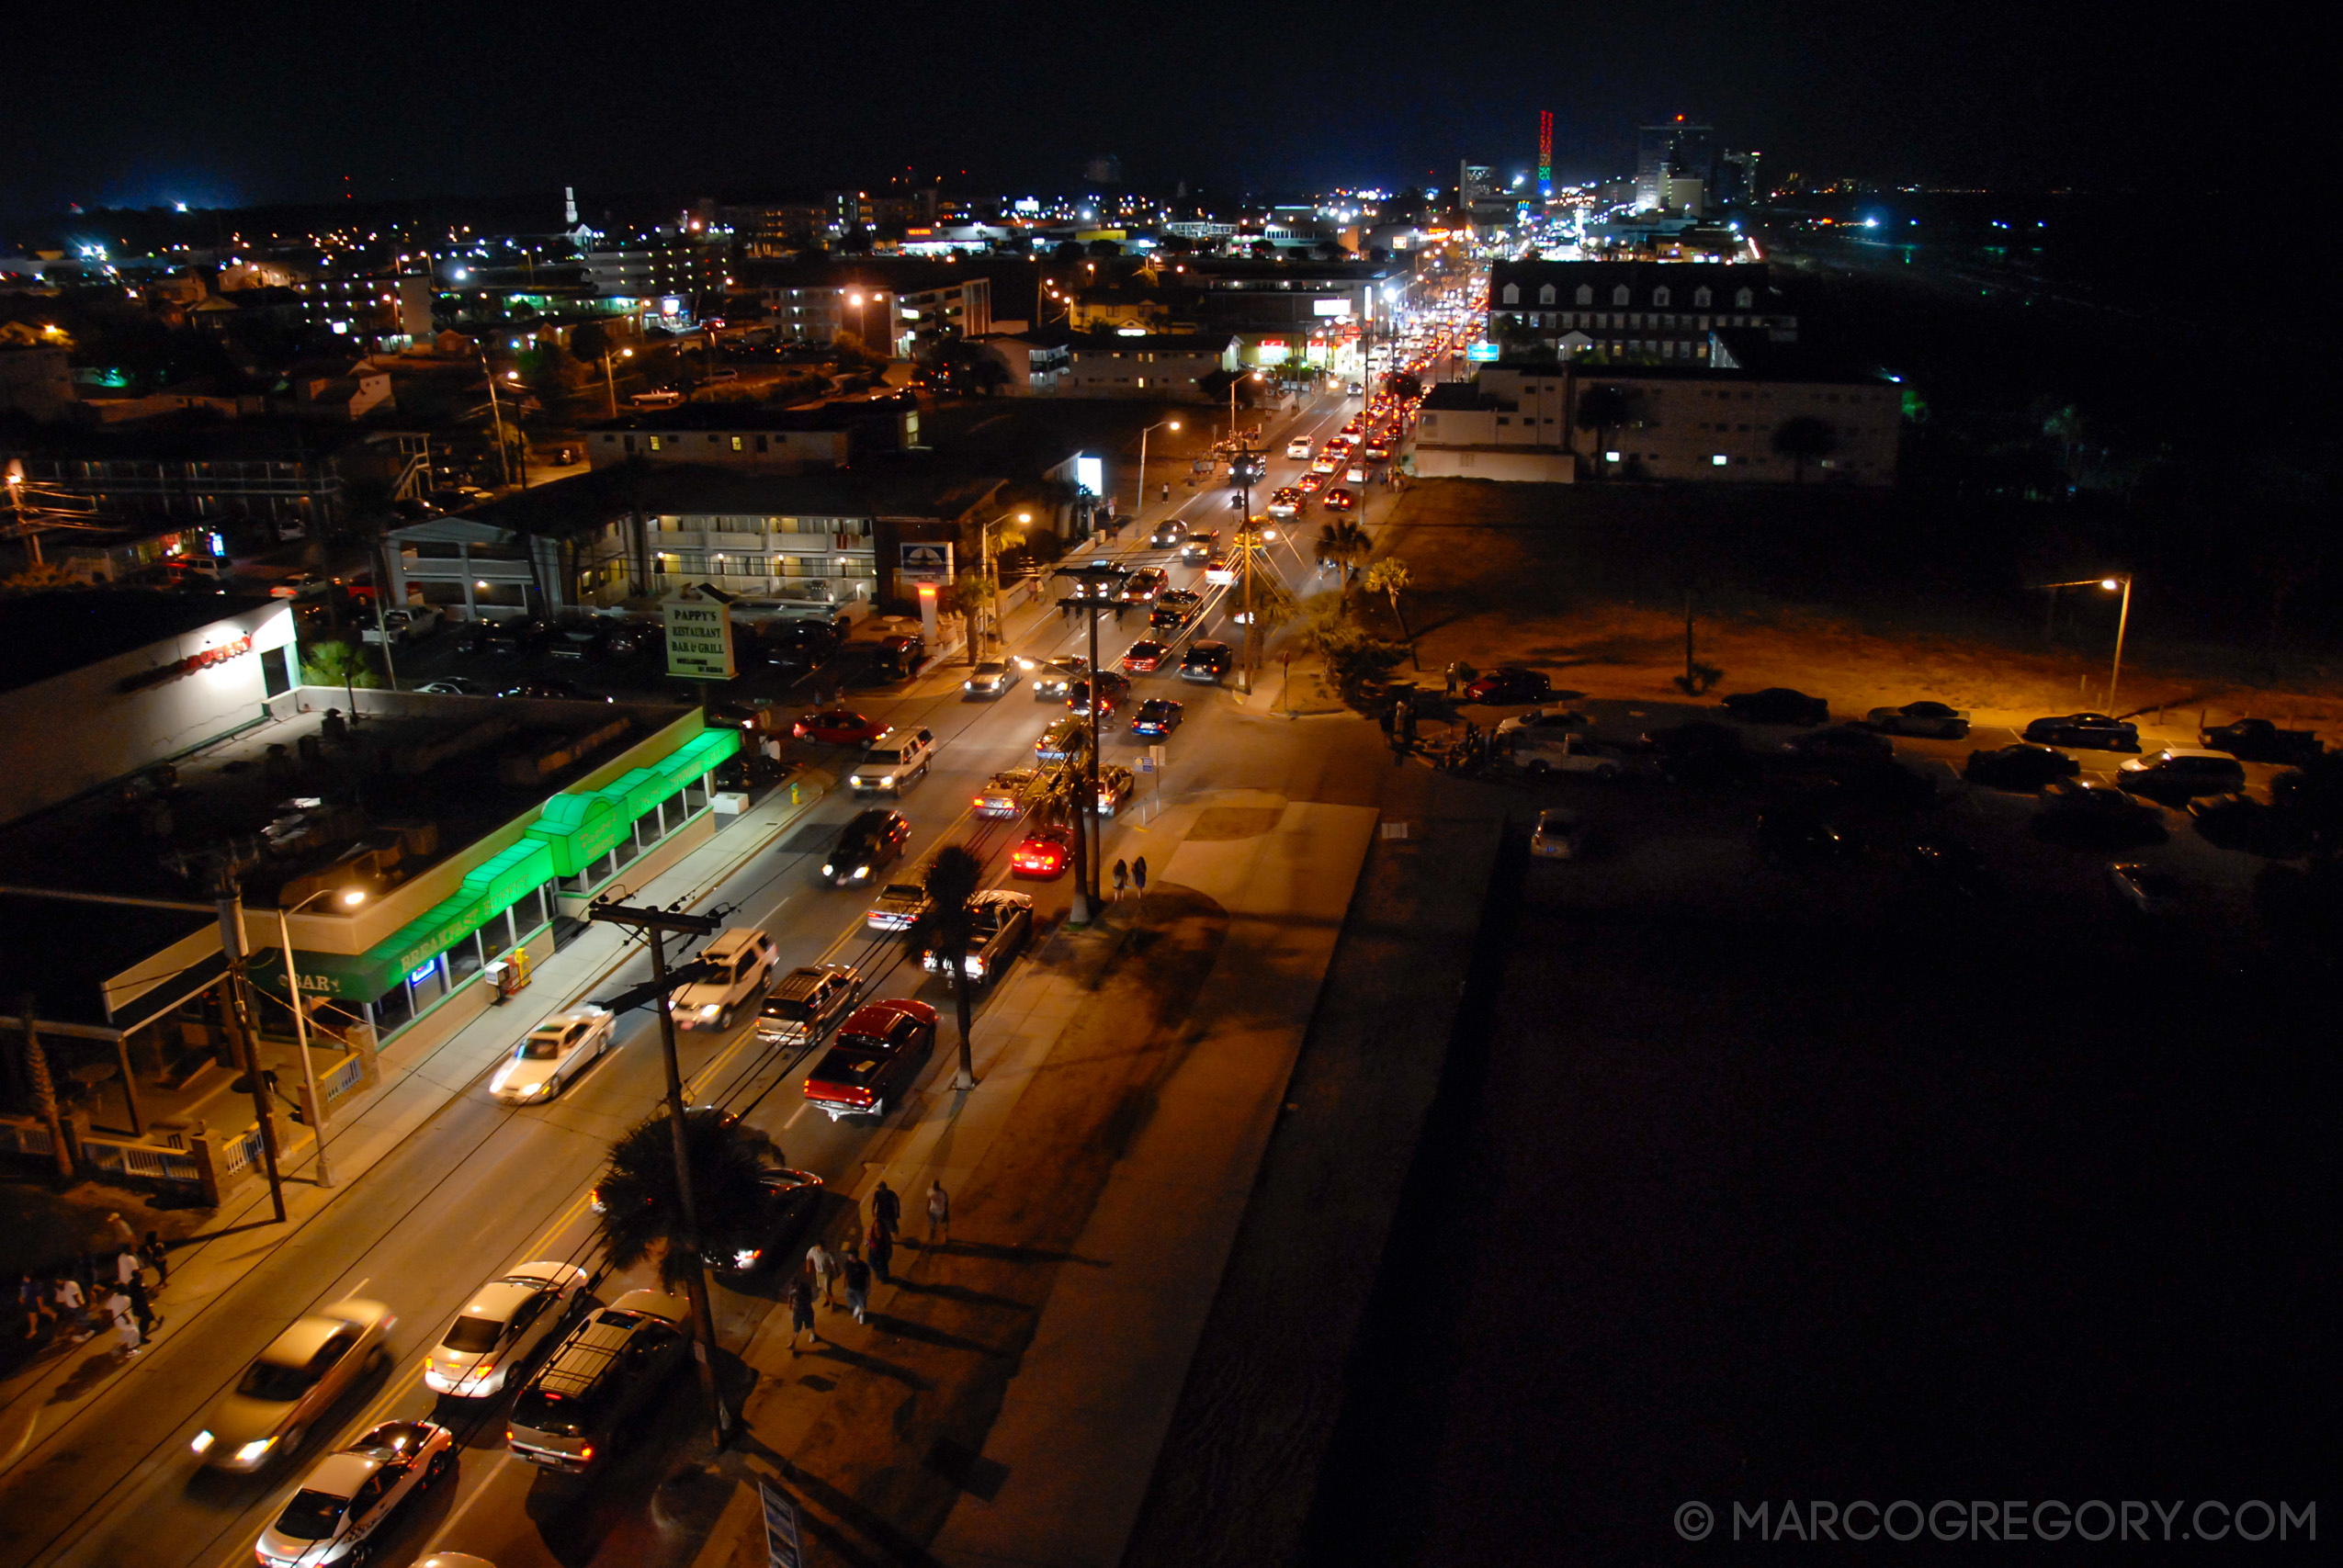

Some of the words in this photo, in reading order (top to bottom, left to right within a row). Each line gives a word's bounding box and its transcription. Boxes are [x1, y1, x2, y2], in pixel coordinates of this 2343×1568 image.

[674, 610, 717, 621] PAPPY'S
[673, 626, 720, 638] RESTAURANT
[672, 641, 689, 652] BAR
[698, 643, 724, 654] GRILL
[401, 908, 479, 974] BREAKFAST
[483, 874, 529, 916] BUFFET
